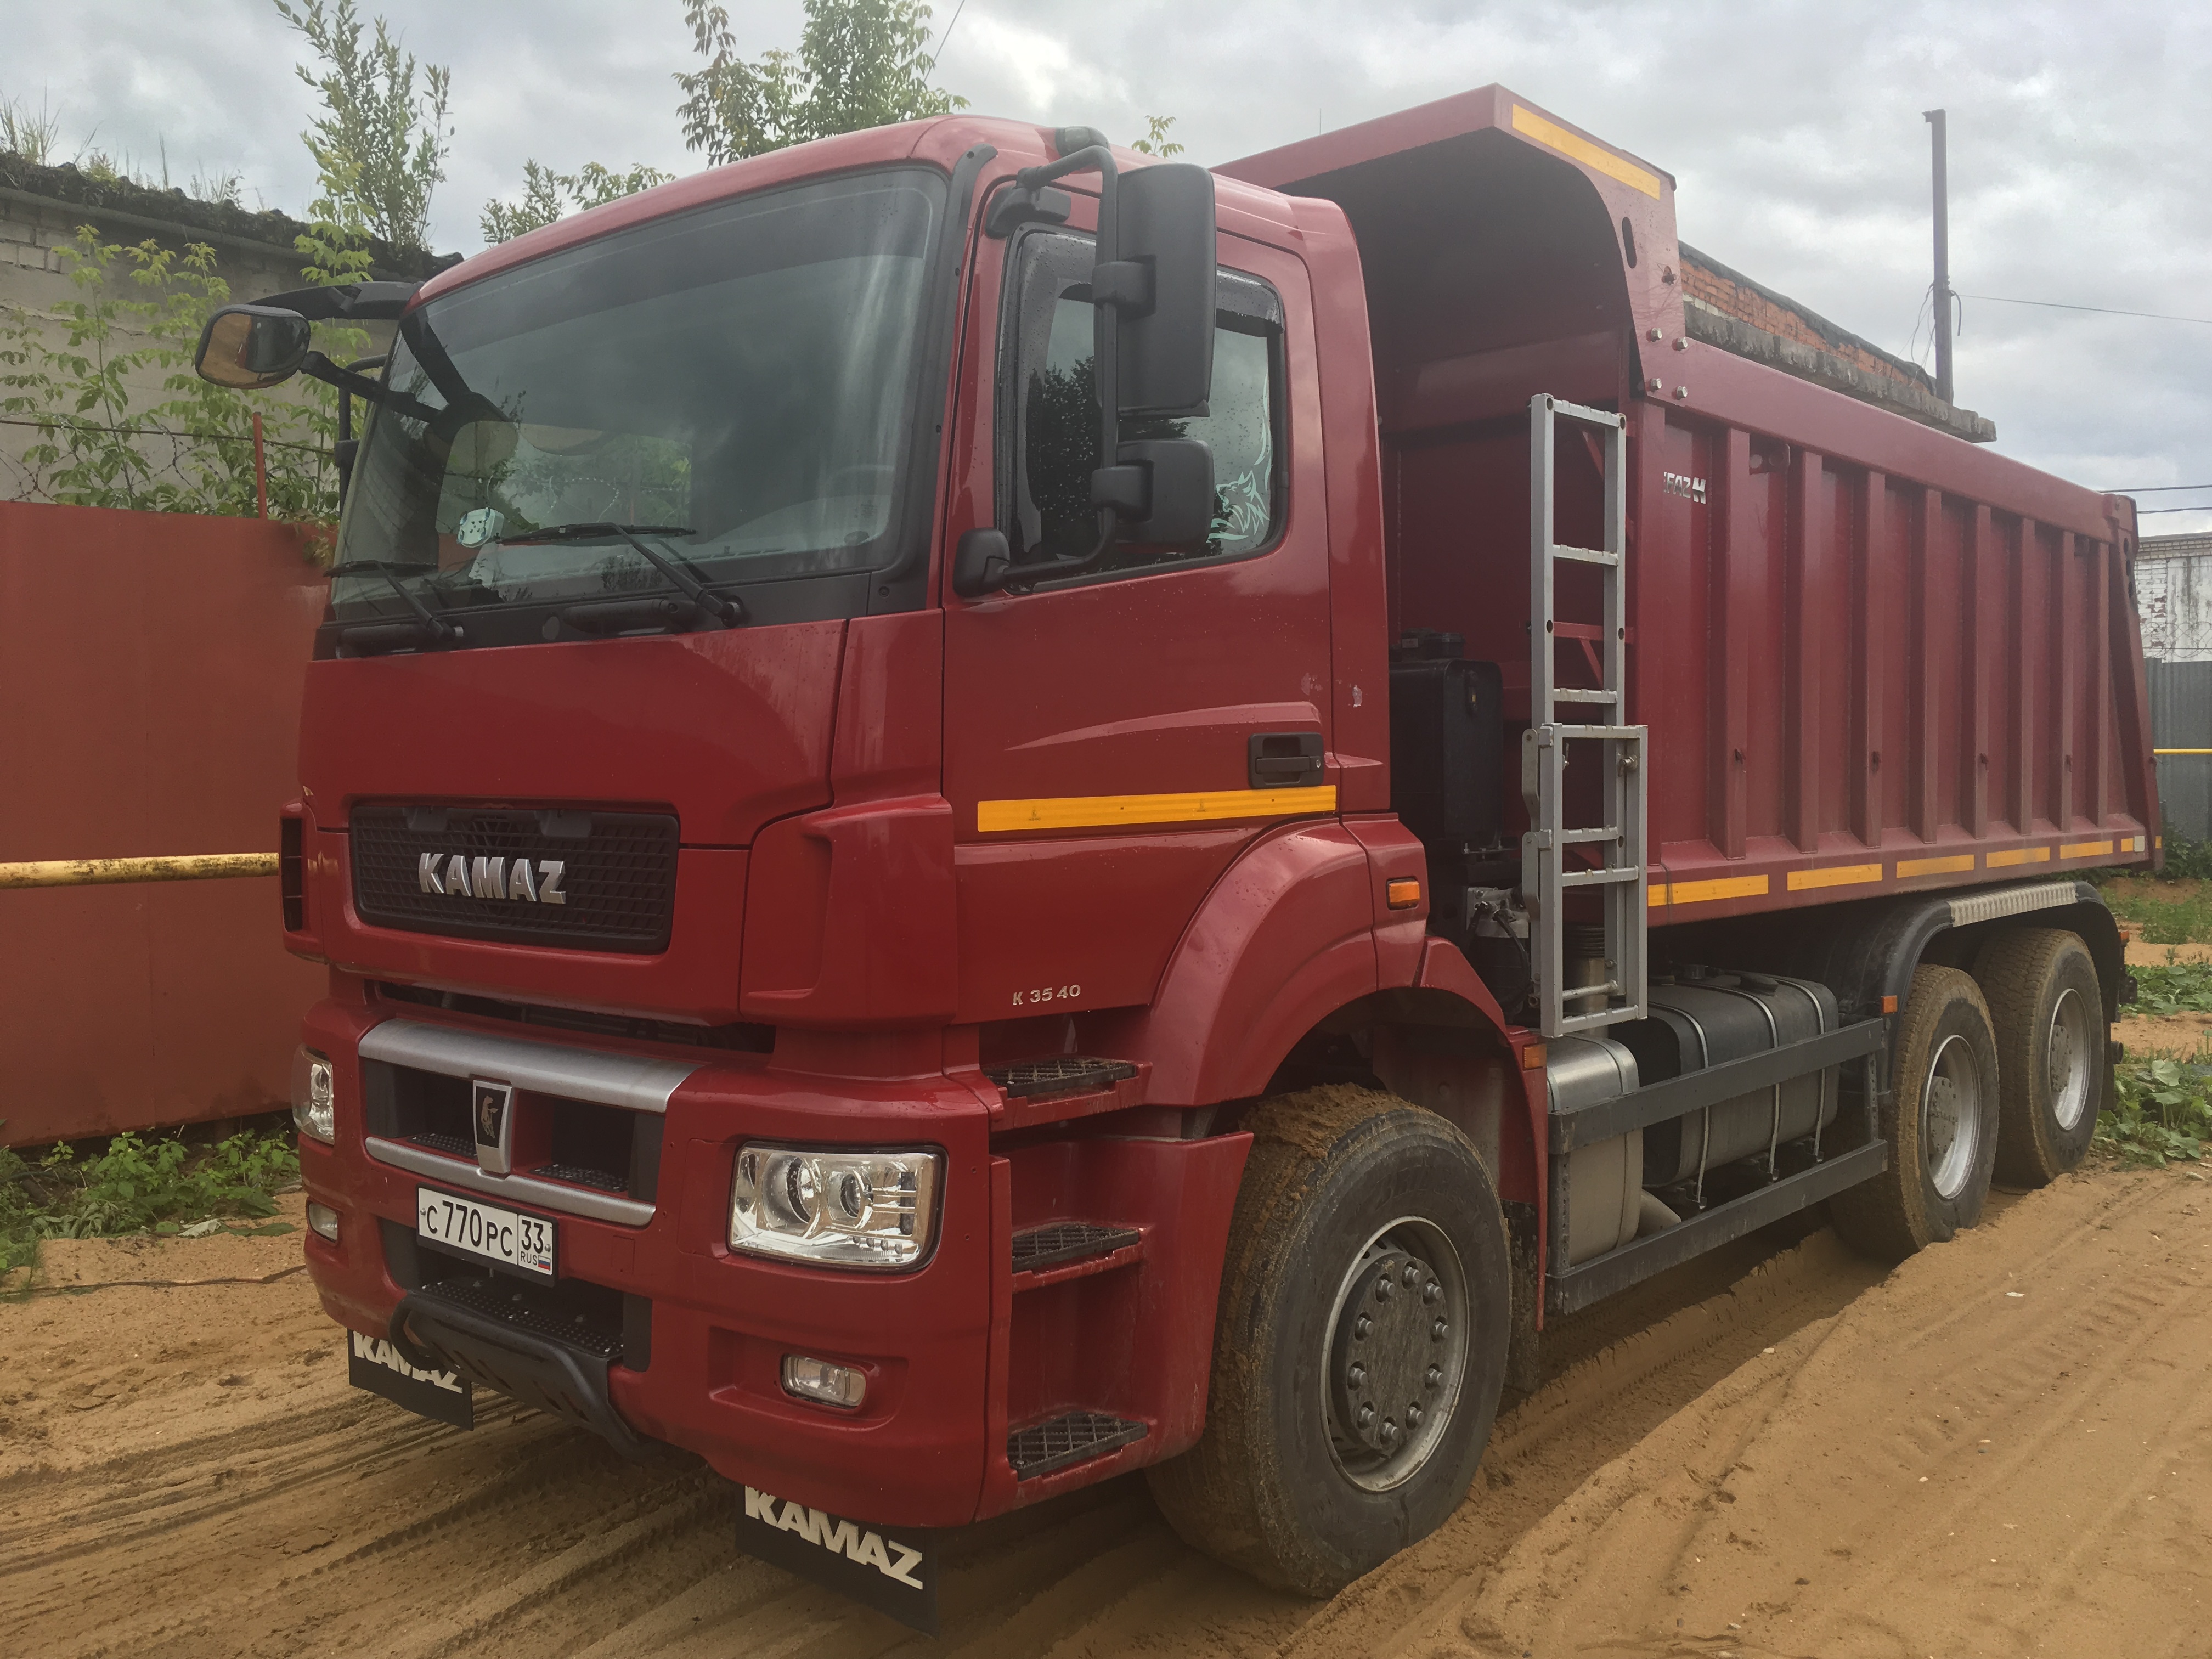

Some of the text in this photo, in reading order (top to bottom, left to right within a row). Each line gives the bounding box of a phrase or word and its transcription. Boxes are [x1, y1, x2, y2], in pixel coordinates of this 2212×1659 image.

[419, 853, 567, 904] KAMAZ
[1013, 991, 1023, 1006] K
[521, 1218, 544, 1254] 33
[520, 1251, 538, 1266] RUS
[744, 1485, 923, 1590] KAMAZ
